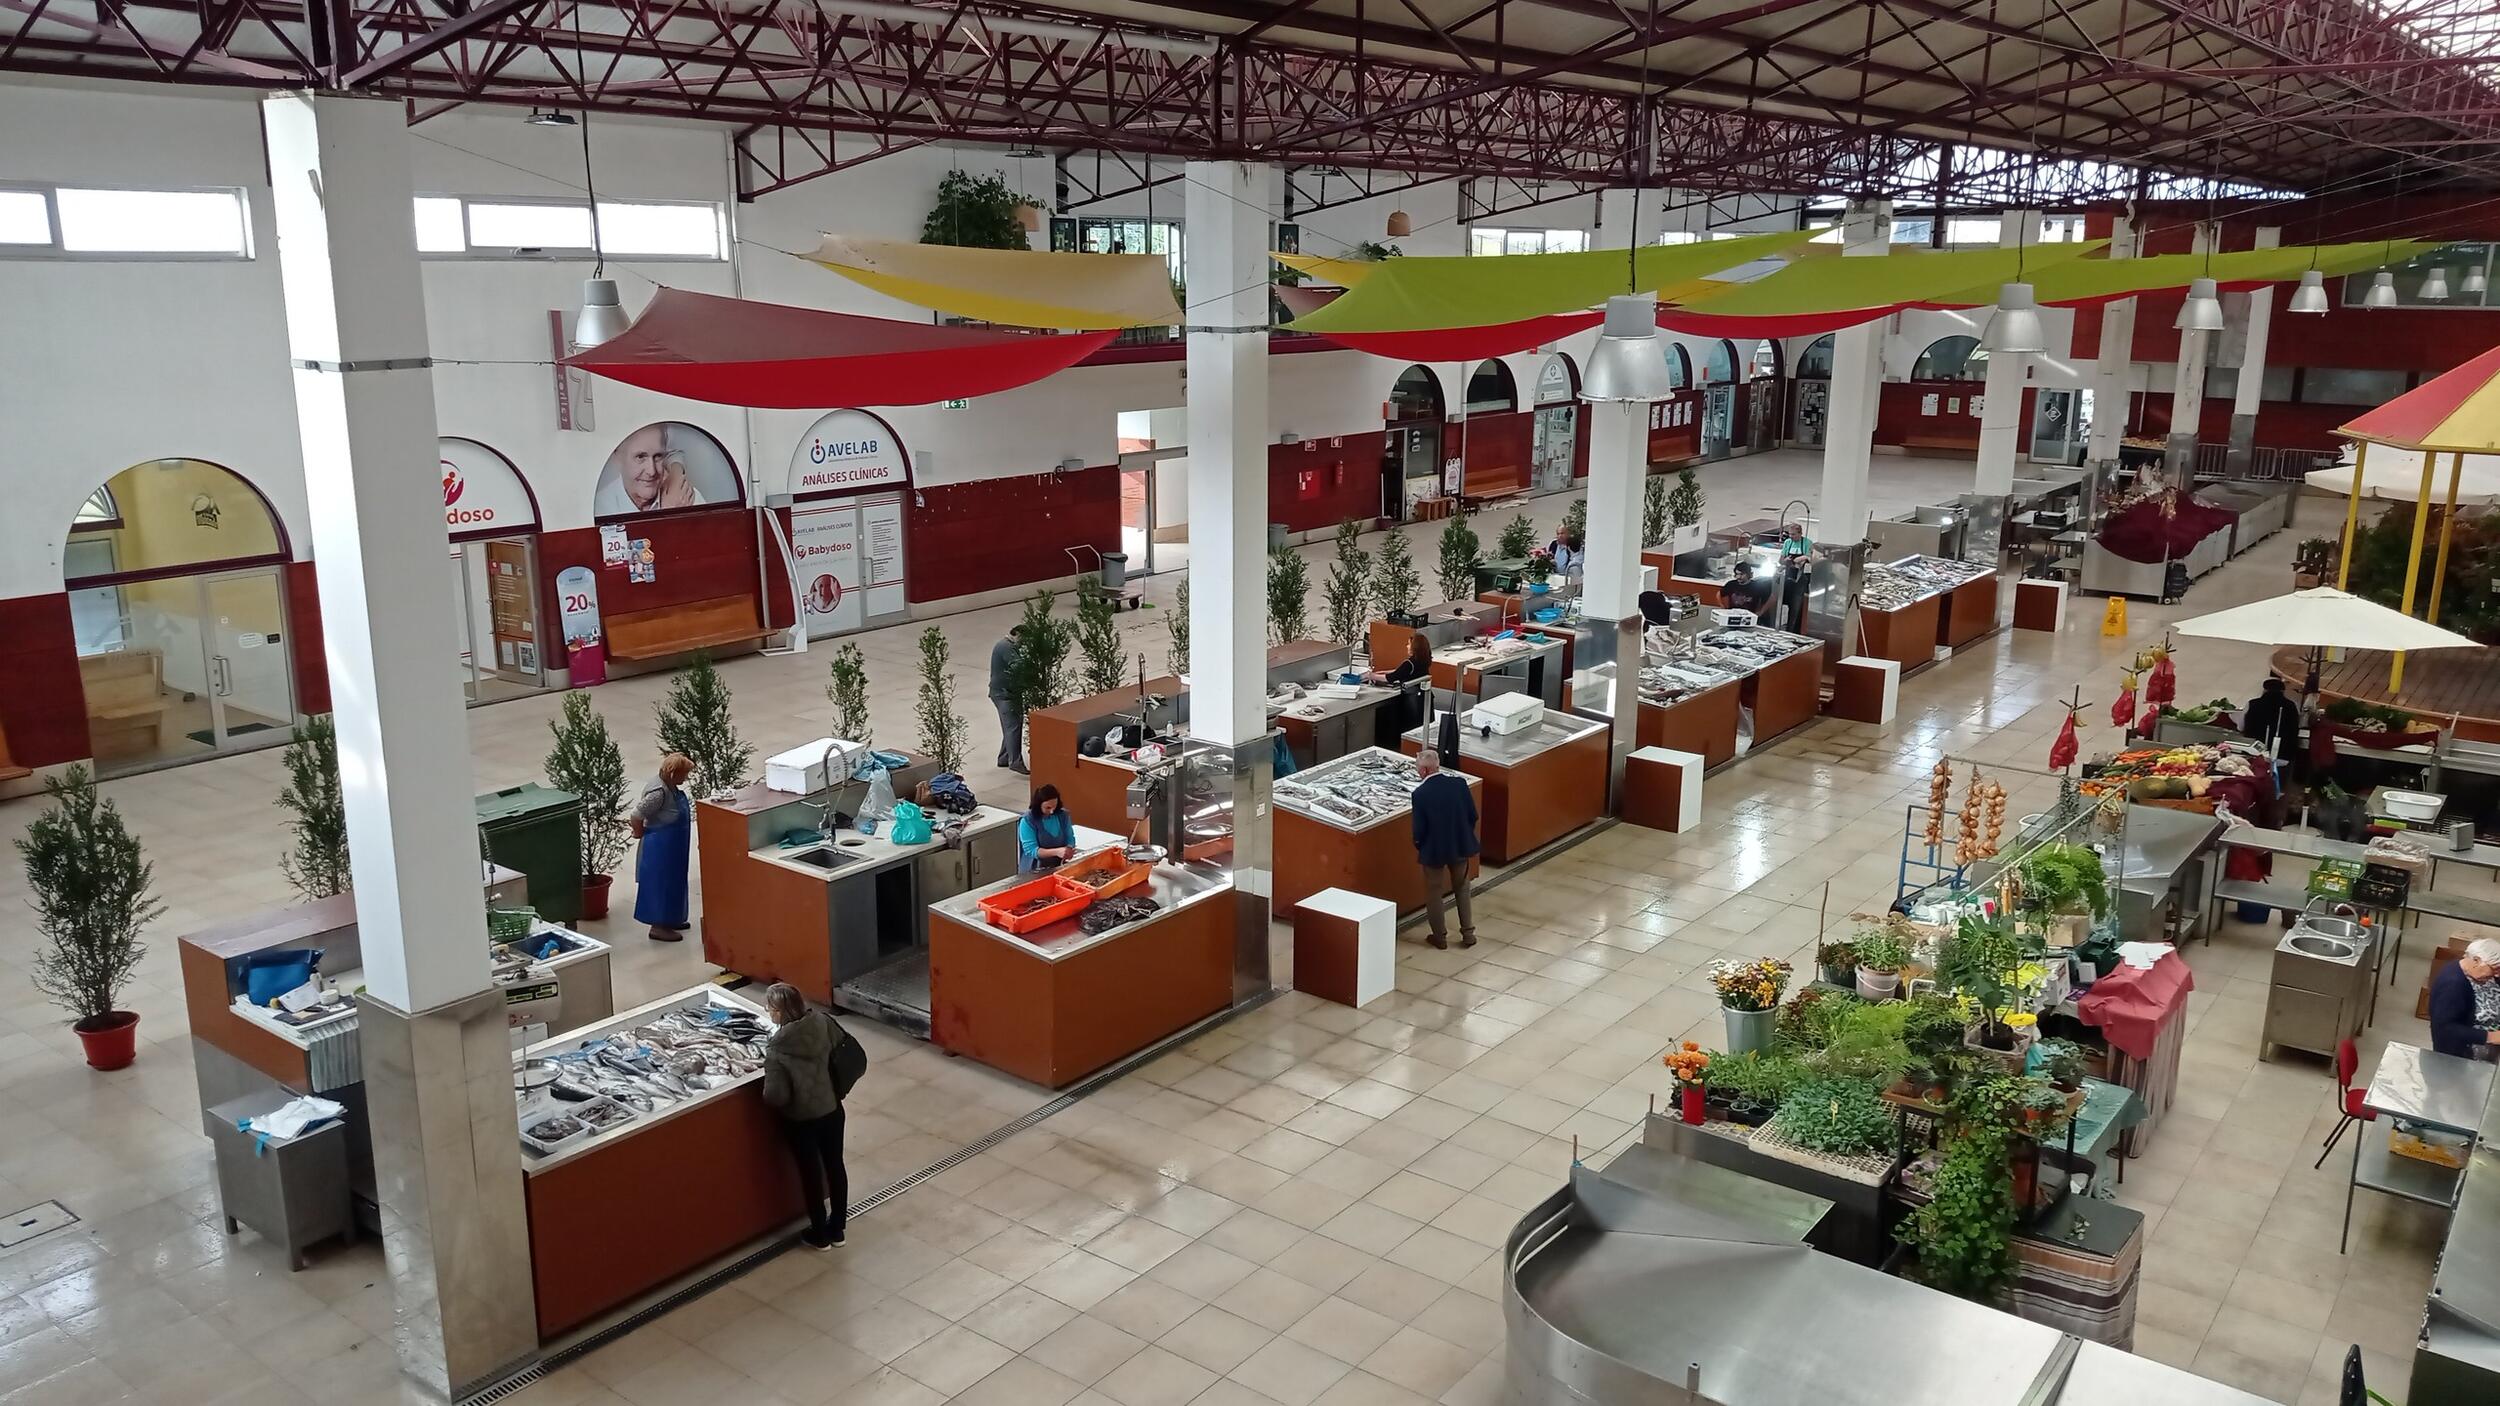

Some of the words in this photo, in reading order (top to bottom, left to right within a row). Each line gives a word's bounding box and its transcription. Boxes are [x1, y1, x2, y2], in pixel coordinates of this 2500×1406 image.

[828, 440, 878, 457] AVELAB
[802, 471, 847, 486] ANÁLISES
[848, 466, 889, 481] CLÍNICAS
[446, 508, 494, 524] doso
[808, 542, 852, 555] Babydoso
